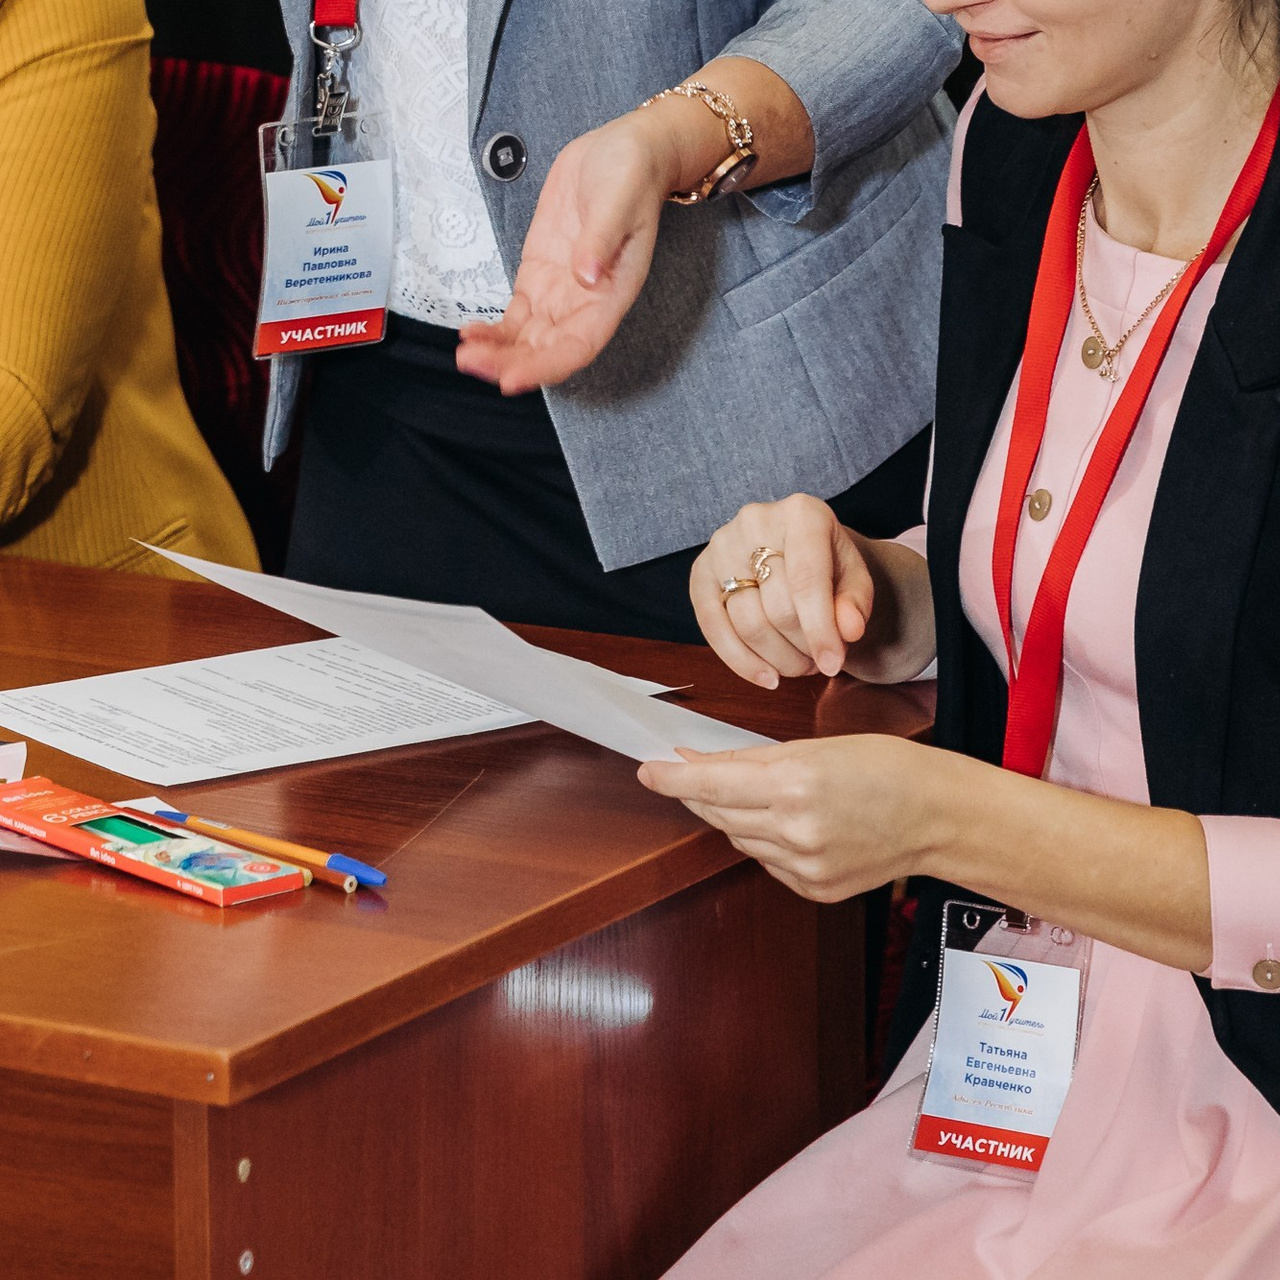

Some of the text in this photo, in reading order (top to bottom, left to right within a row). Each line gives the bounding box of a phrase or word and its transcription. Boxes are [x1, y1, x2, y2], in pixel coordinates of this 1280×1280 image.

[313, 244, 349, 257] Ирина
[302, 257, 357, 272] Павловна
[285, 270, 372, 289] Веретенникова
[280, 320, 368, 345] УЧАСТНИК
[42, 813, 68, 823] 6
[90, 847, 116, 865] Art idea
[1000, 1007, 1007, 1021] 1
[979, 1041, 1028, 1060] Татьяна
[965, 1056, 1037, 1079] Евгеньевна
[965, 1073, 1032, 1094] Кравченко
[938, 1131, 1035, 1162] УЧАСТНИК
